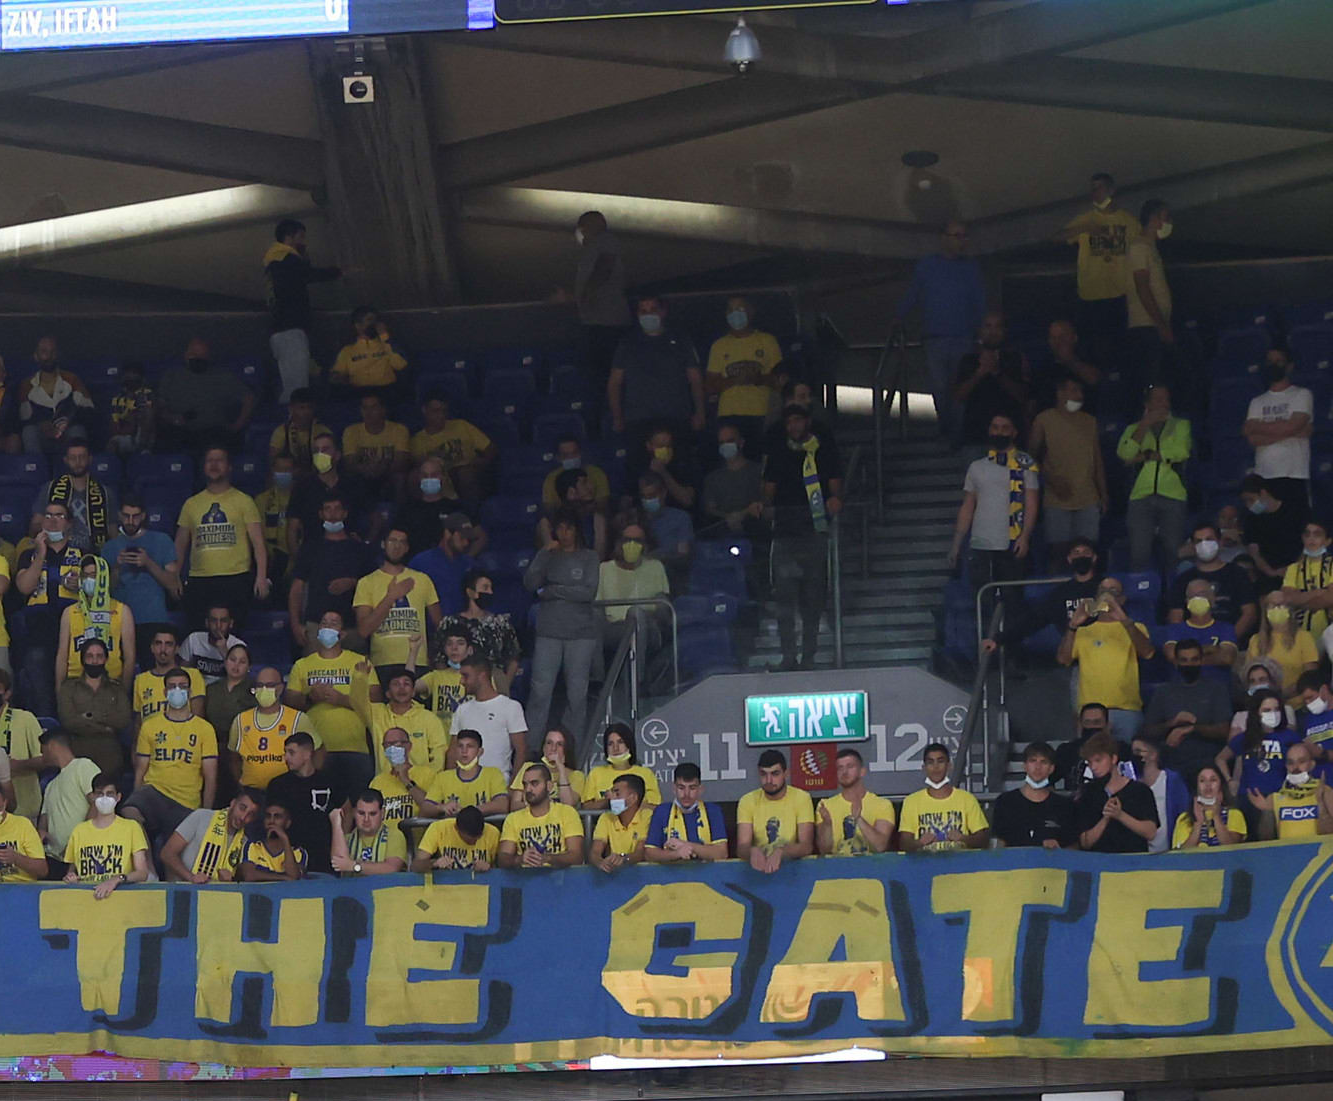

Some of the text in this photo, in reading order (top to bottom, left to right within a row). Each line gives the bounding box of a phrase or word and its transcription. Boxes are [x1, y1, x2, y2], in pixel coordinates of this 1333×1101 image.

[6, 11, 49, 38] ZIV,
[54, 7, 116, 34] IFTAH
[308, 669, 337, 677] MACCABI
[142, 701, 171, 715] ELIT
[789, 698, 856, 739] יציאה
[189, 734, 196, 746] 9
[258, 737, 268, 751] 8
[871, 724, 927, 772] 12
[155, 749, 193, 764] ELITE
[692, 732, 746, 780] 11
[1281, 808, 1315, 818] FOX
[521, 826, 541, 839] NOW
[81, 846, 122, 858] NOW I'M
[80, 858, 122, 874] BACK
[39, 868, 1226, 1028] THE GATE
